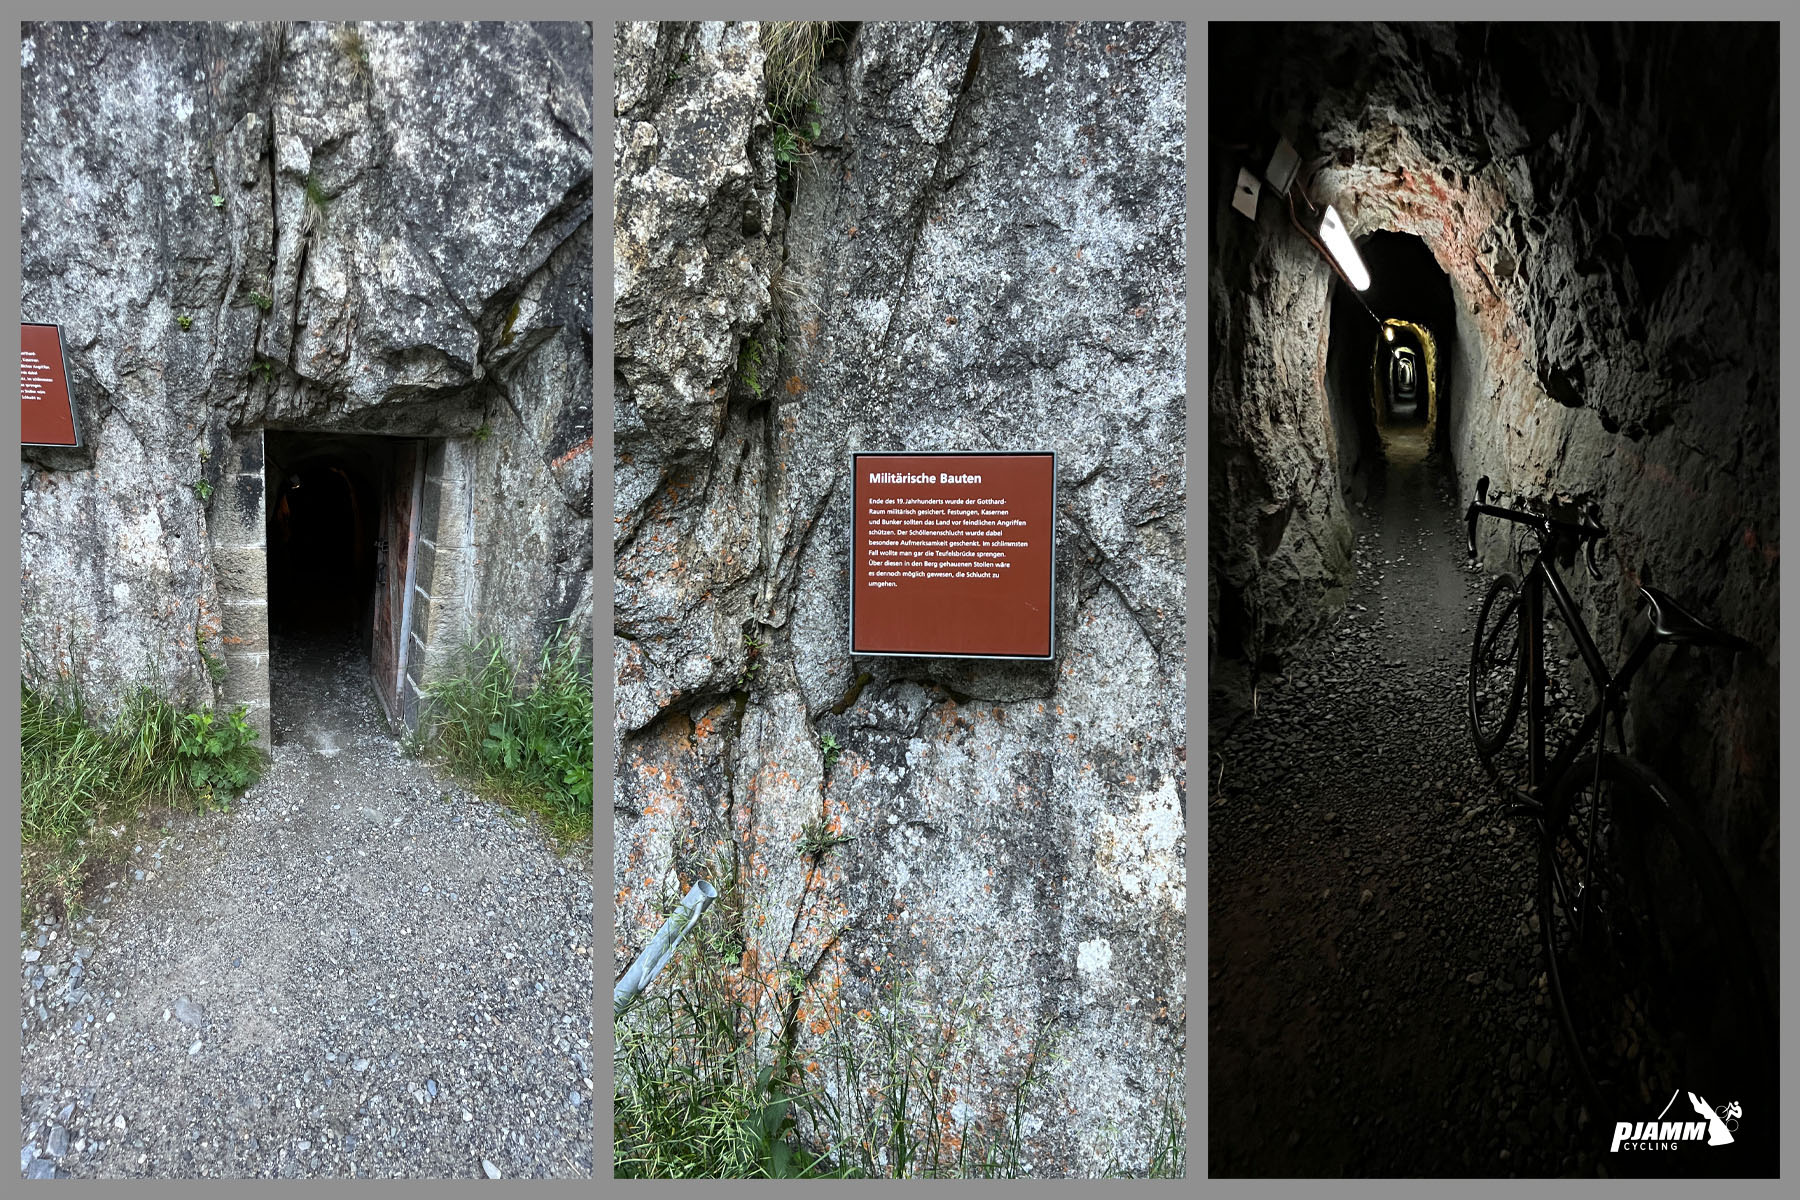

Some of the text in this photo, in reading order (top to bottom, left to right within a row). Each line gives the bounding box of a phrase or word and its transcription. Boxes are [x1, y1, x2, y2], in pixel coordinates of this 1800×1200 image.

[869, 472, 982, 484] Militärische Bauten
[918, 508, 946, 516] gesichert.
[947, 508, 979, 516] Festungen,
[997, 520, 1026, 528] Angriffen
